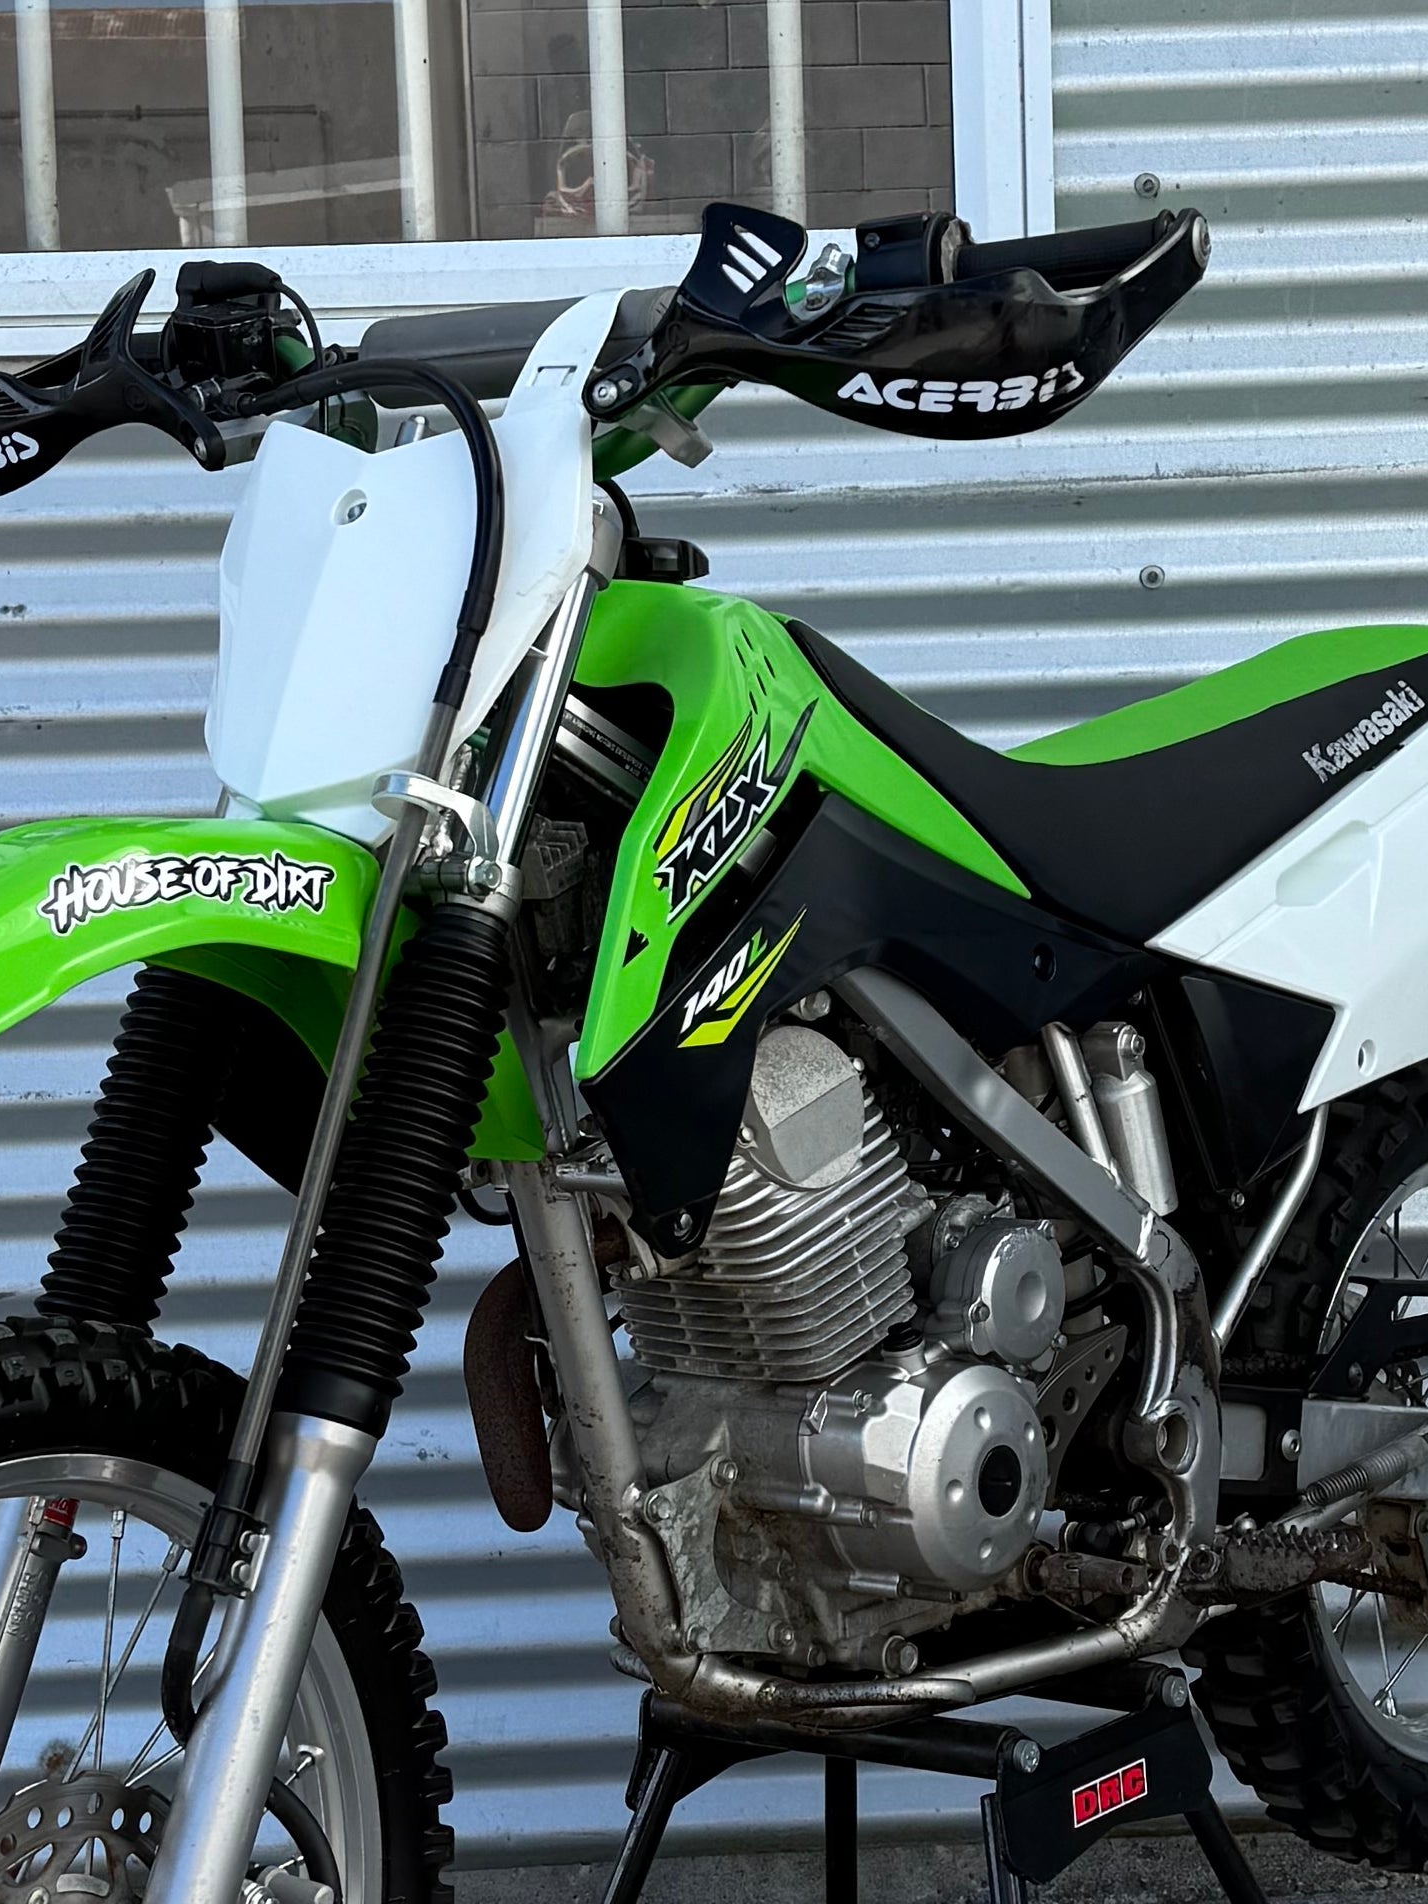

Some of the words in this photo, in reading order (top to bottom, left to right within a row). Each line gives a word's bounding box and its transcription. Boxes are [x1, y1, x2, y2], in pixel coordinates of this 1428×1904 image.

[1301, 679, 1427, 784] Kawasaki
[41, 856, 189, 933] HOUSE
[190, 855, 244, 901] OF
[239, 852, 335, 912] DIRT
[1075, 1765, 1146, 1825] DRC
